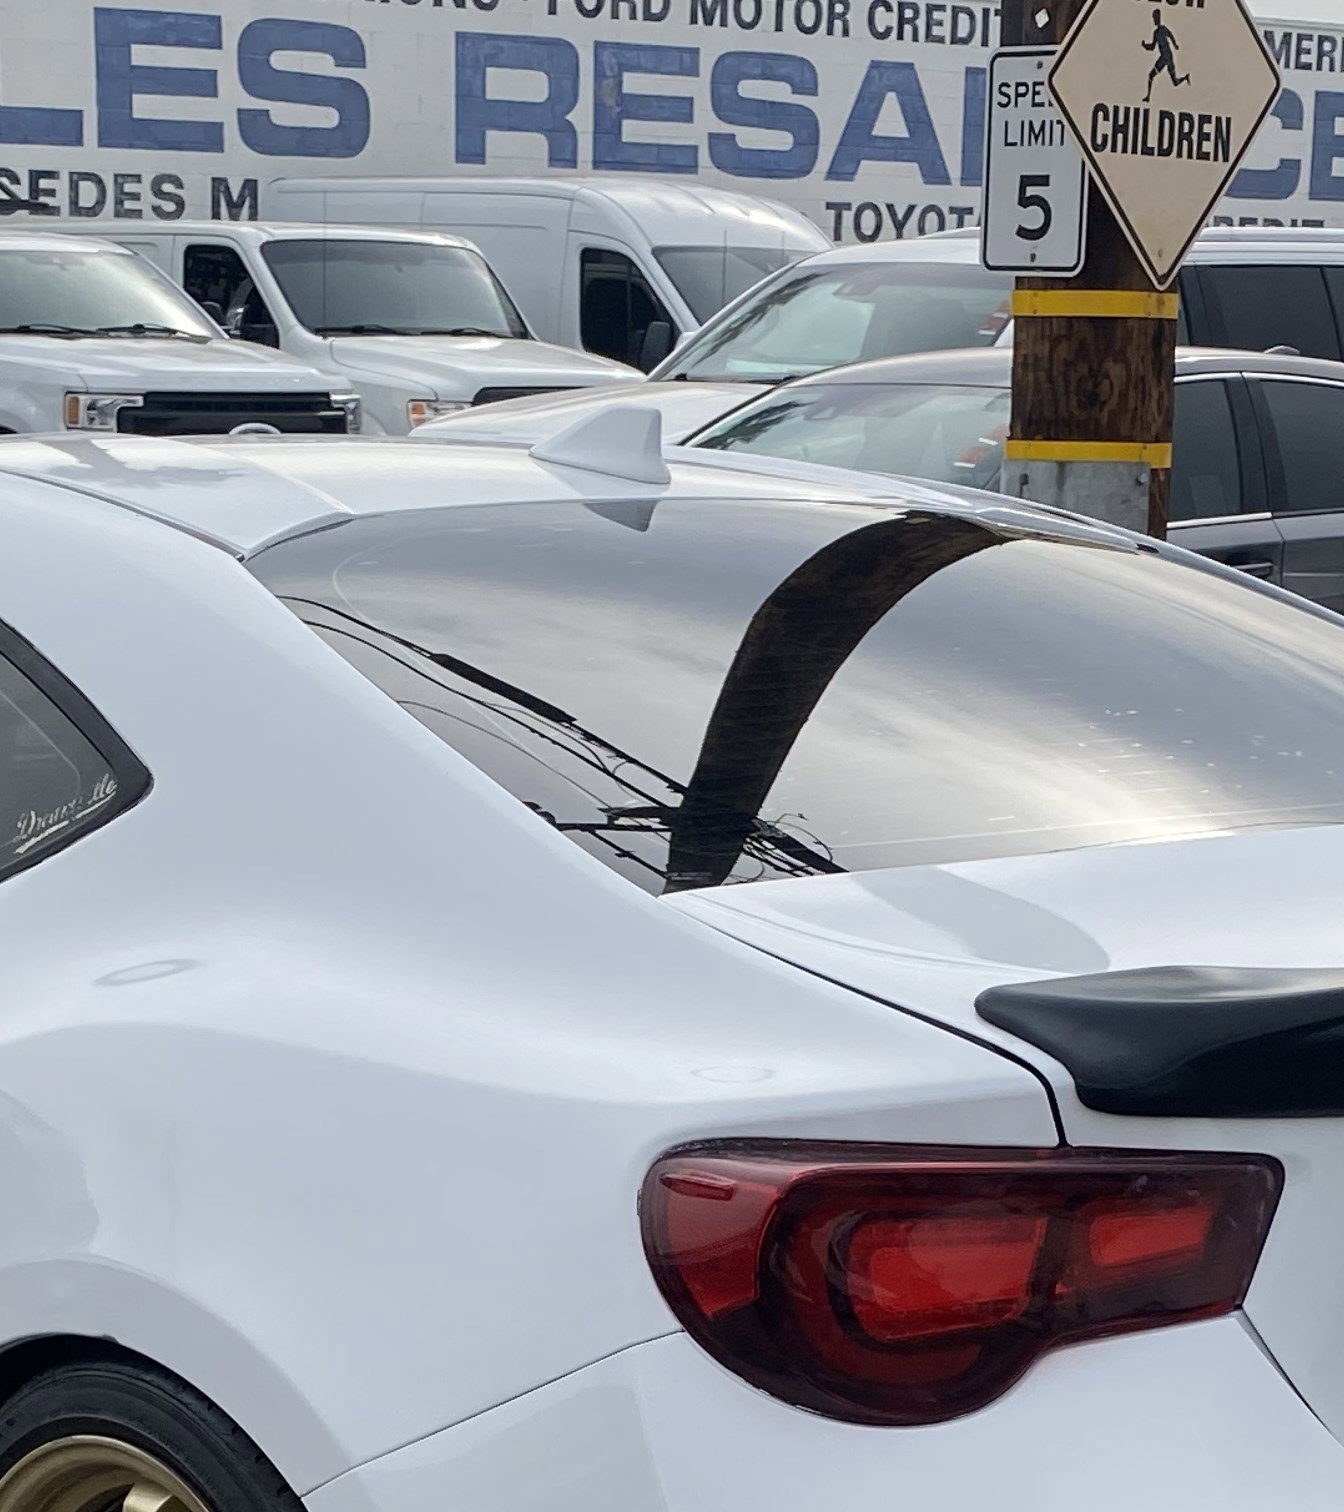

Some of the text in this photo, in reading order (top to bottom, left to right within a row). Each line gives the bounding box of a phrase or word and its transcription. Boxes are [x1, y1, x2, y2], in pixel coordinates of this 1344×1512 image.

[689, 0, 850, 37] MOTOR
[868, 0, 1002, 47] CREDI
[454, 30, 988, 188] RESA
[996, 81, 1054, 109] SPE
[1090, 102, 1233, 163] CHILDREN
[824, 201, 983, 243] TOYOT
[1015, 174, 1052, 241] 5
